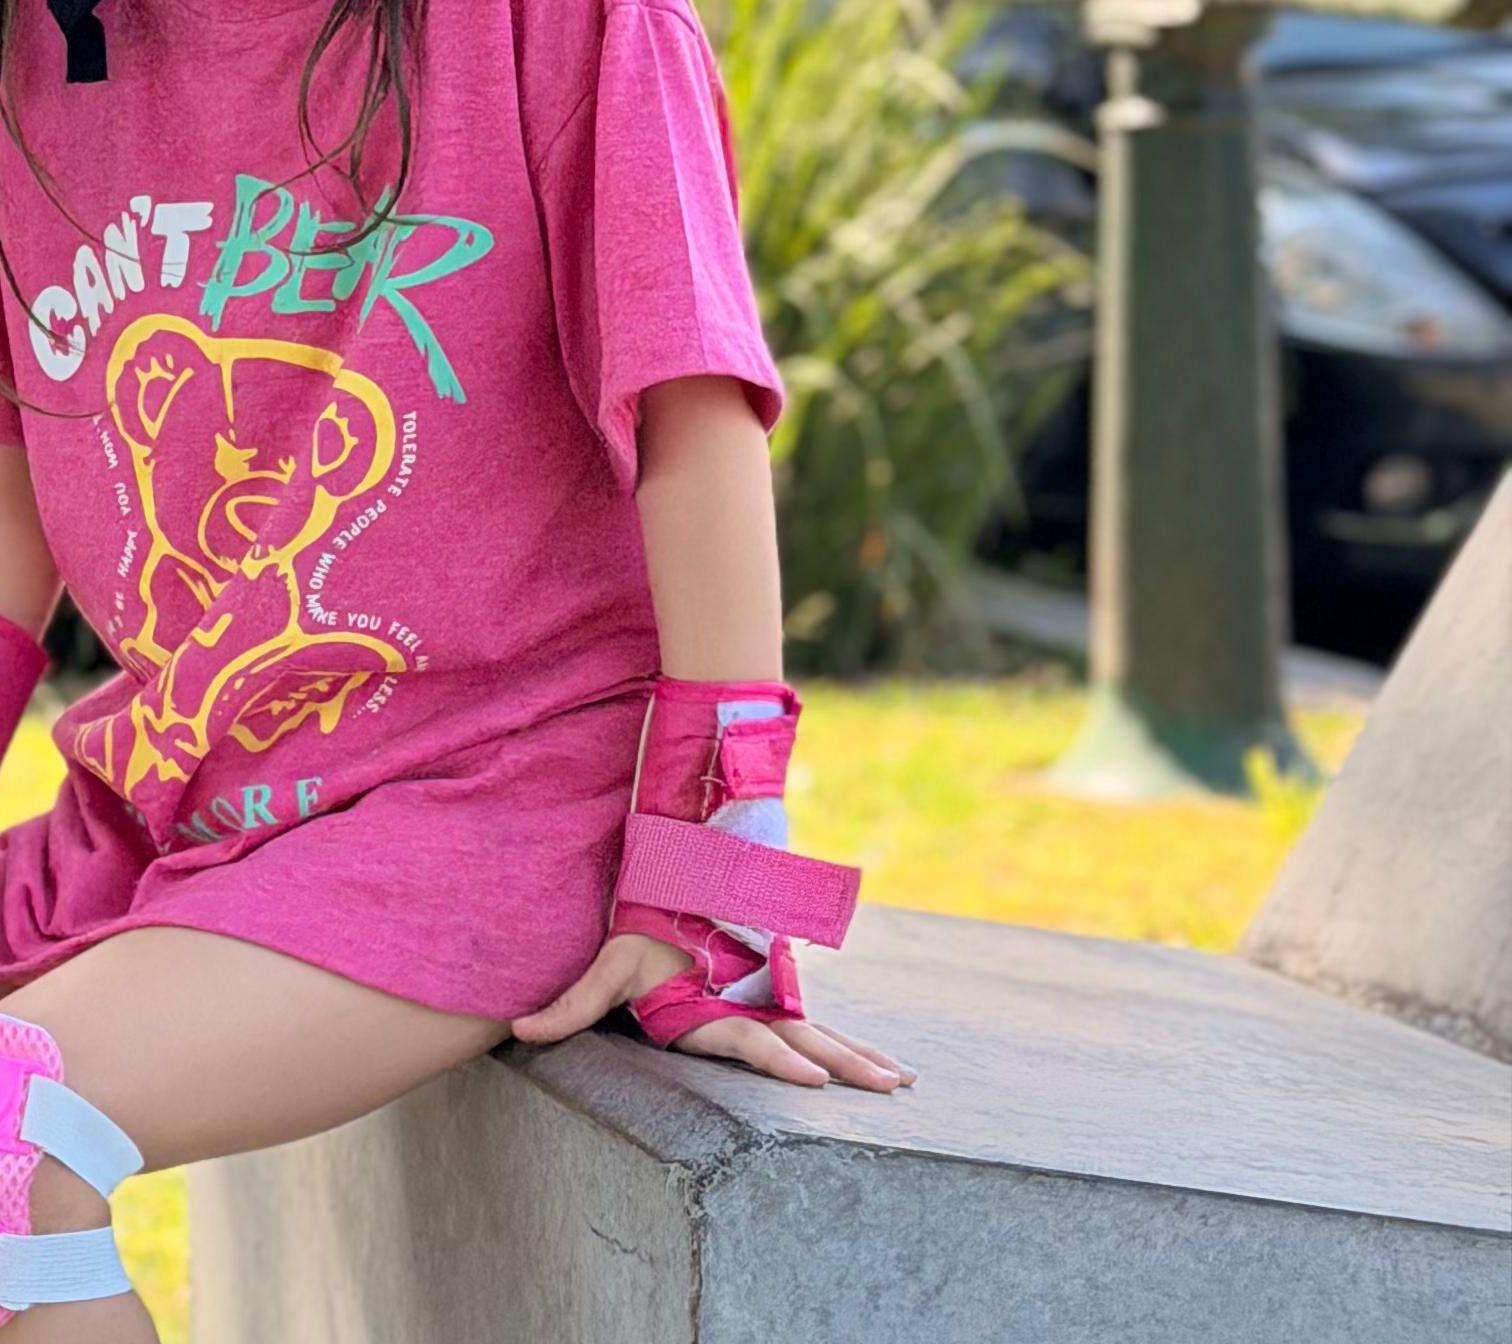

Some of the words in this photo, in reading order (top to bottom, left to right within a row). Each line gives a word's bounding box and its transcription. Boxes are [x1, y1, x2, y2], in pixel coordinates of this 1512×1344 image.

[28, 194, 215, 382] CAN'T
[197, 173, 495, 405] BEAR
[388, 410, 418, 497] TOLERATE
[114, 481, 132, 517] YOU
[332, 499, 387, 550] PEOPLE
[308, 552, 337, 591] WHO
[347, 612, 382, 631] YOU
[387, 620, 423, 653] FEEL
